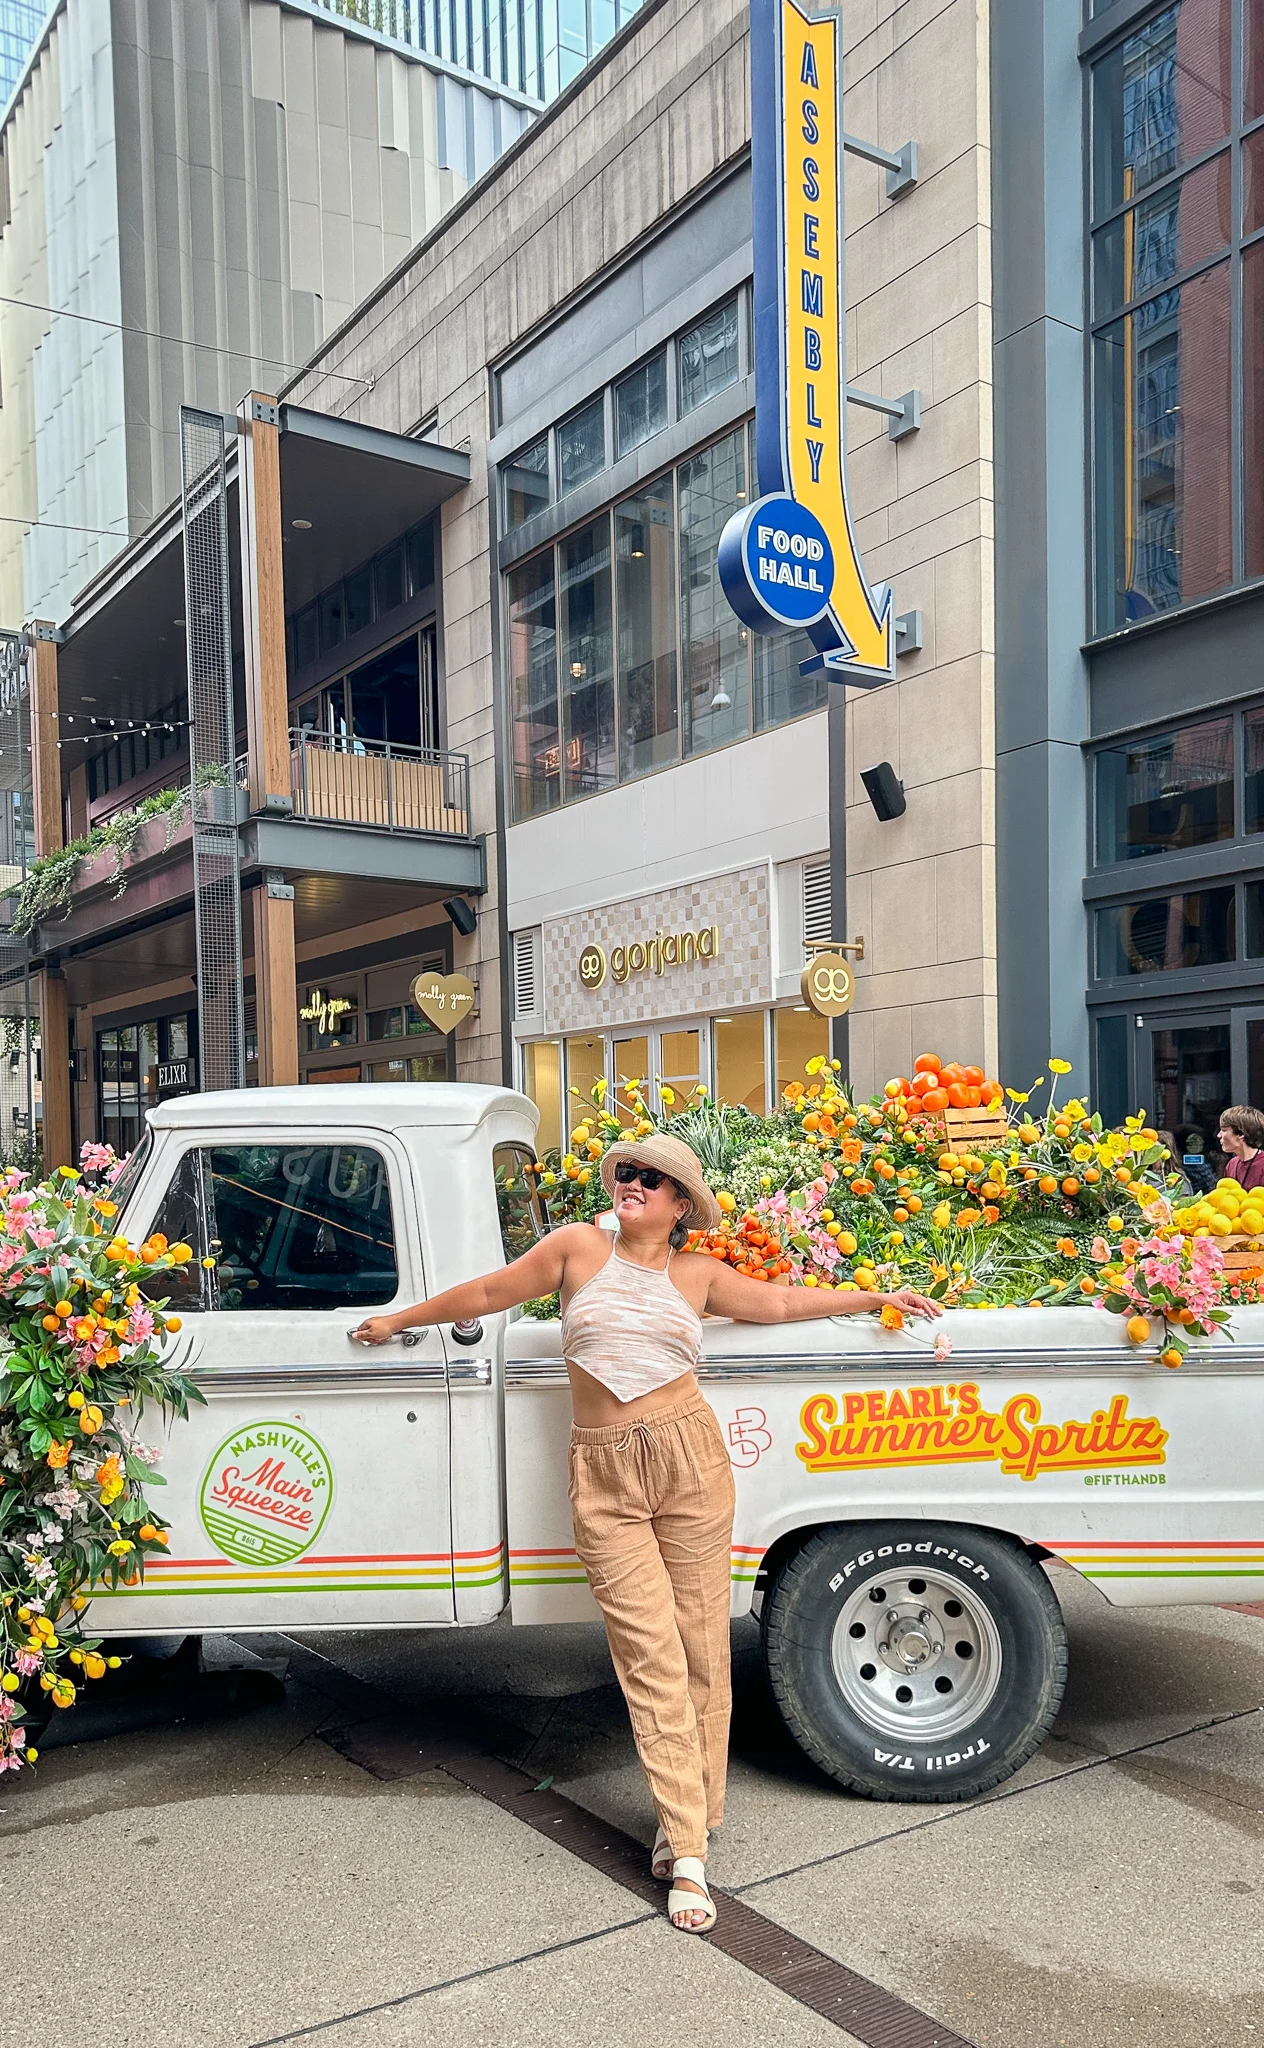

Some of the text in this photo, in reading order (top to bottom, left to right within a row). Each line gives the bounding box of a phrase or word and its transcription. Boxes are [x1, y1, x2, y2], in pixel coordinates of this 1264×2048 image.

[800, 41, 824, 484] ASSEMBLY
[757, 525, 824, 562] FOOD
[758, 557, 824, 593] HALL
[611, 925, 719, 984] gorjana
[300, 989, 351, 1034] molly green
[418, 985, 474, 1011] molly green
[158, 1063, 187, 1087] ELIXR
[845, 1384, 979, 1424] PEARL'S
[799, 1396, 1164, 1477] Summer Spritz
[230, 1432, 326, 1489] NASHVILLE'S
[241, 1456, 314, 1503] Main
[1083, 1473, 1167, 1487] @FIFTHANDB
[213, 1466, 314, 1524] Squeeze
[828, 1541, 991, 1593] BFGoodrich
[874, 1738, 991, 1770] Trail T/A
